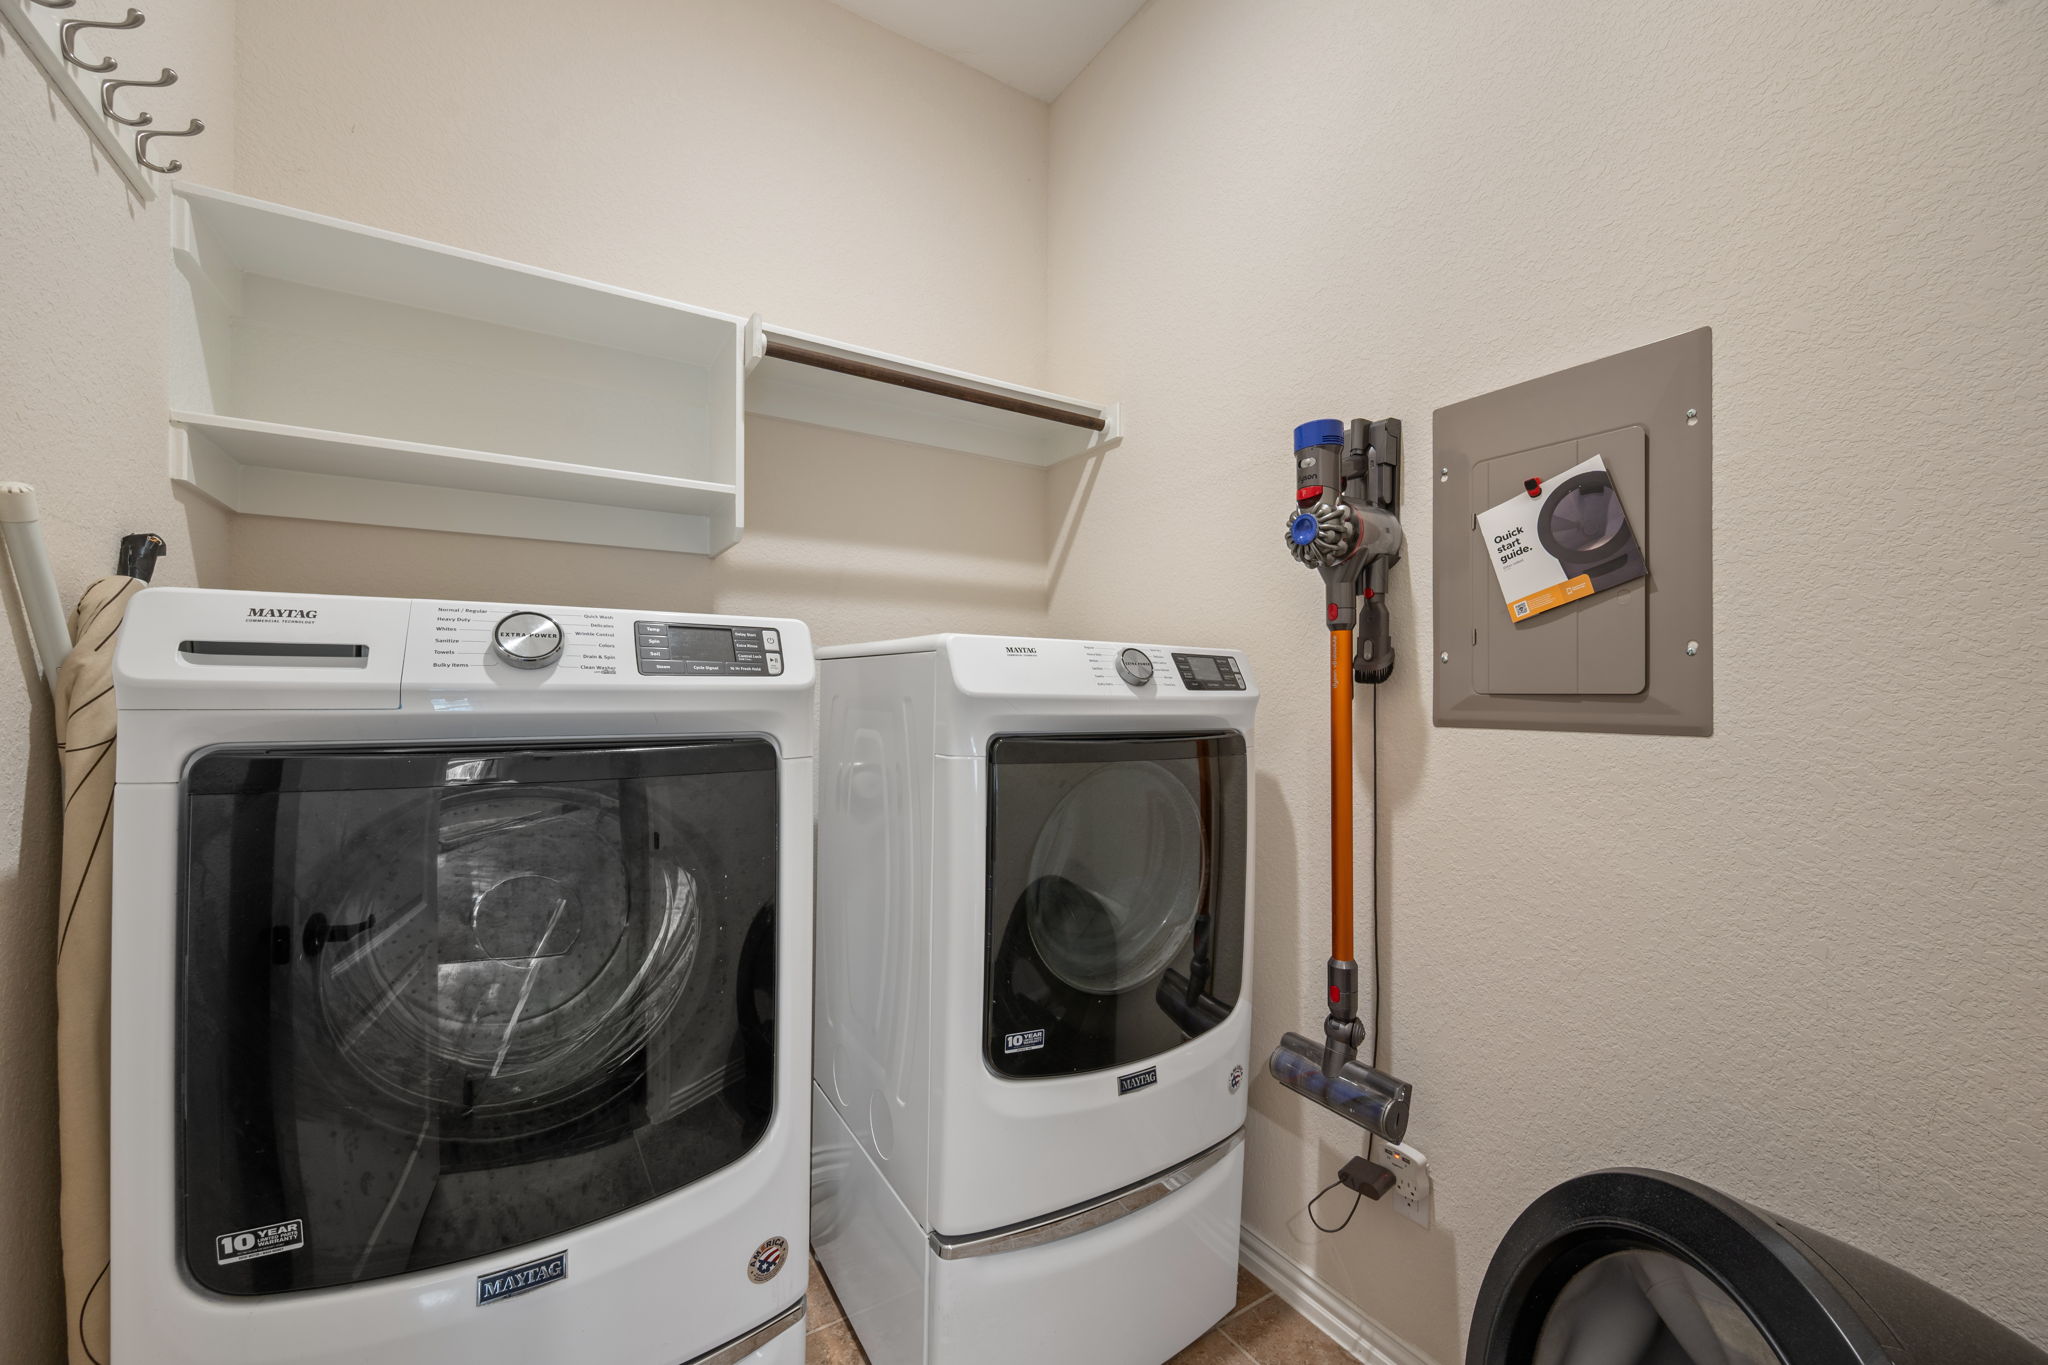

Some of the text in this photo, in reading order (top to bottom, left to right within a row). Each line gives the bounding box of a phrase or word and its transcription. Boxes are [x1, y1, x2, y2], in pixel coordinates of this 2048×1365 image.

[1494, 526, 1524, 544] Quick
[1497, 538, 1521, 554] start
[1500, 546, 1533, 564] guide.
[247, 608, 318, 619] MAYTAG
[1007, 1035, 1023, 1047] 10
[1121, 1071, 1156, 1091] MAYTAG
[221, 1233, 255, 1255] 10
[257, 1223, 298, 1237] YEAR
[257, 1235, 298, 1247] WARRANTY
[750, 1238, 785, 1267] AMRICA
[483, 1260, 562, 1298] MAYTAG
